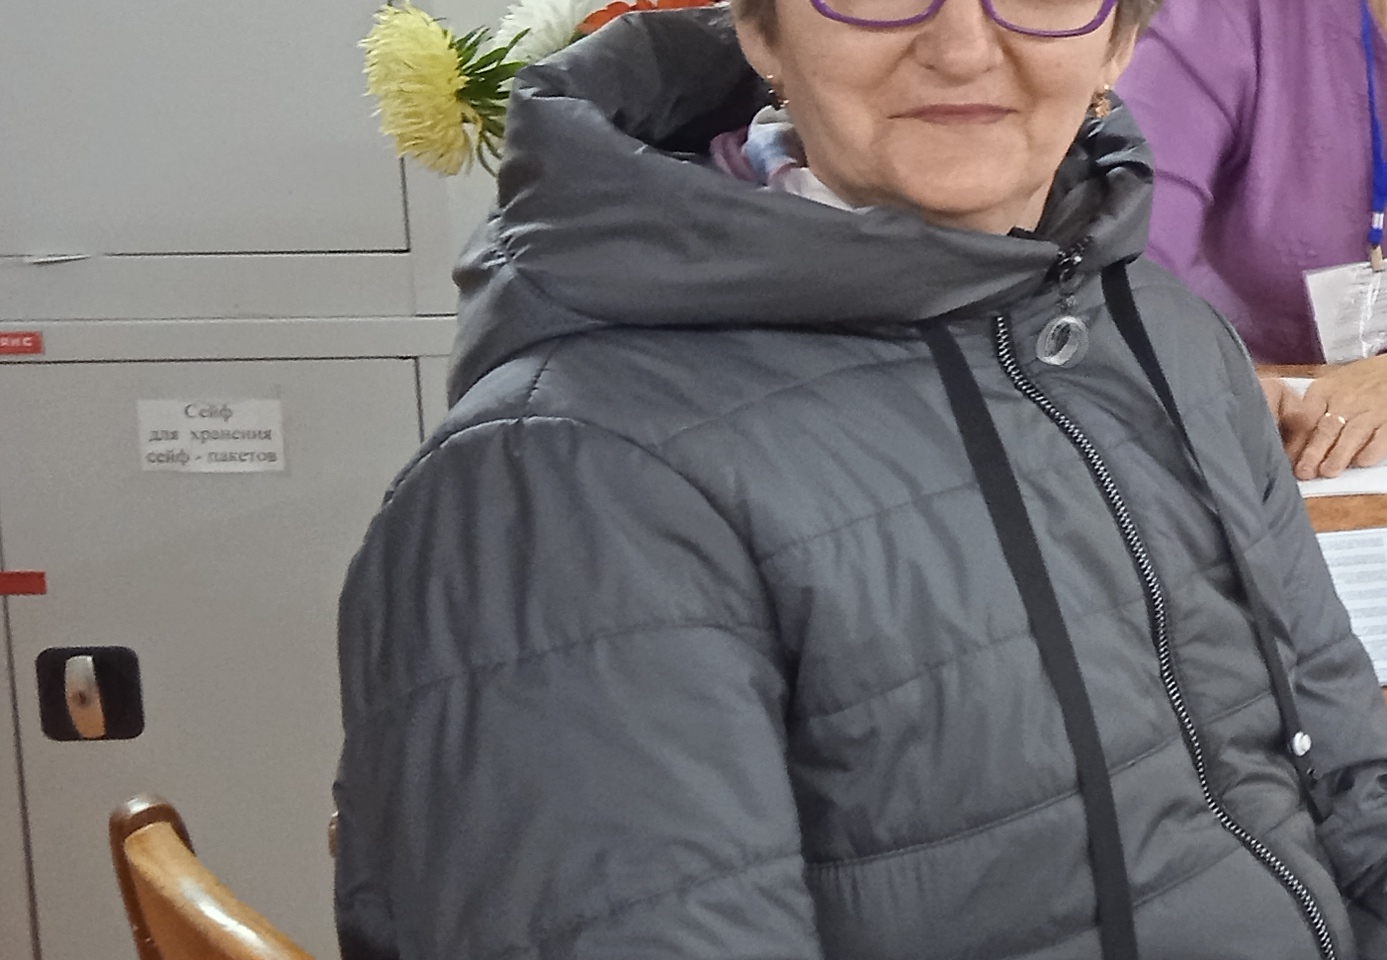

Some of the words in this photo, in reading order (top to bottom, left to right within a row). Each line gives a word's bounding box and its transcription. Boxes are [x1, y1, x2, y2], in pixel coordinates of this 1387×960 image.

[184, 402, 234, 423] Сейф
[149, 428, 179, 442] для
[190, 427, 272, 444] хранения
[146, 447, 190, 466] сейф
[207, 449, 278, 464] пакетов
